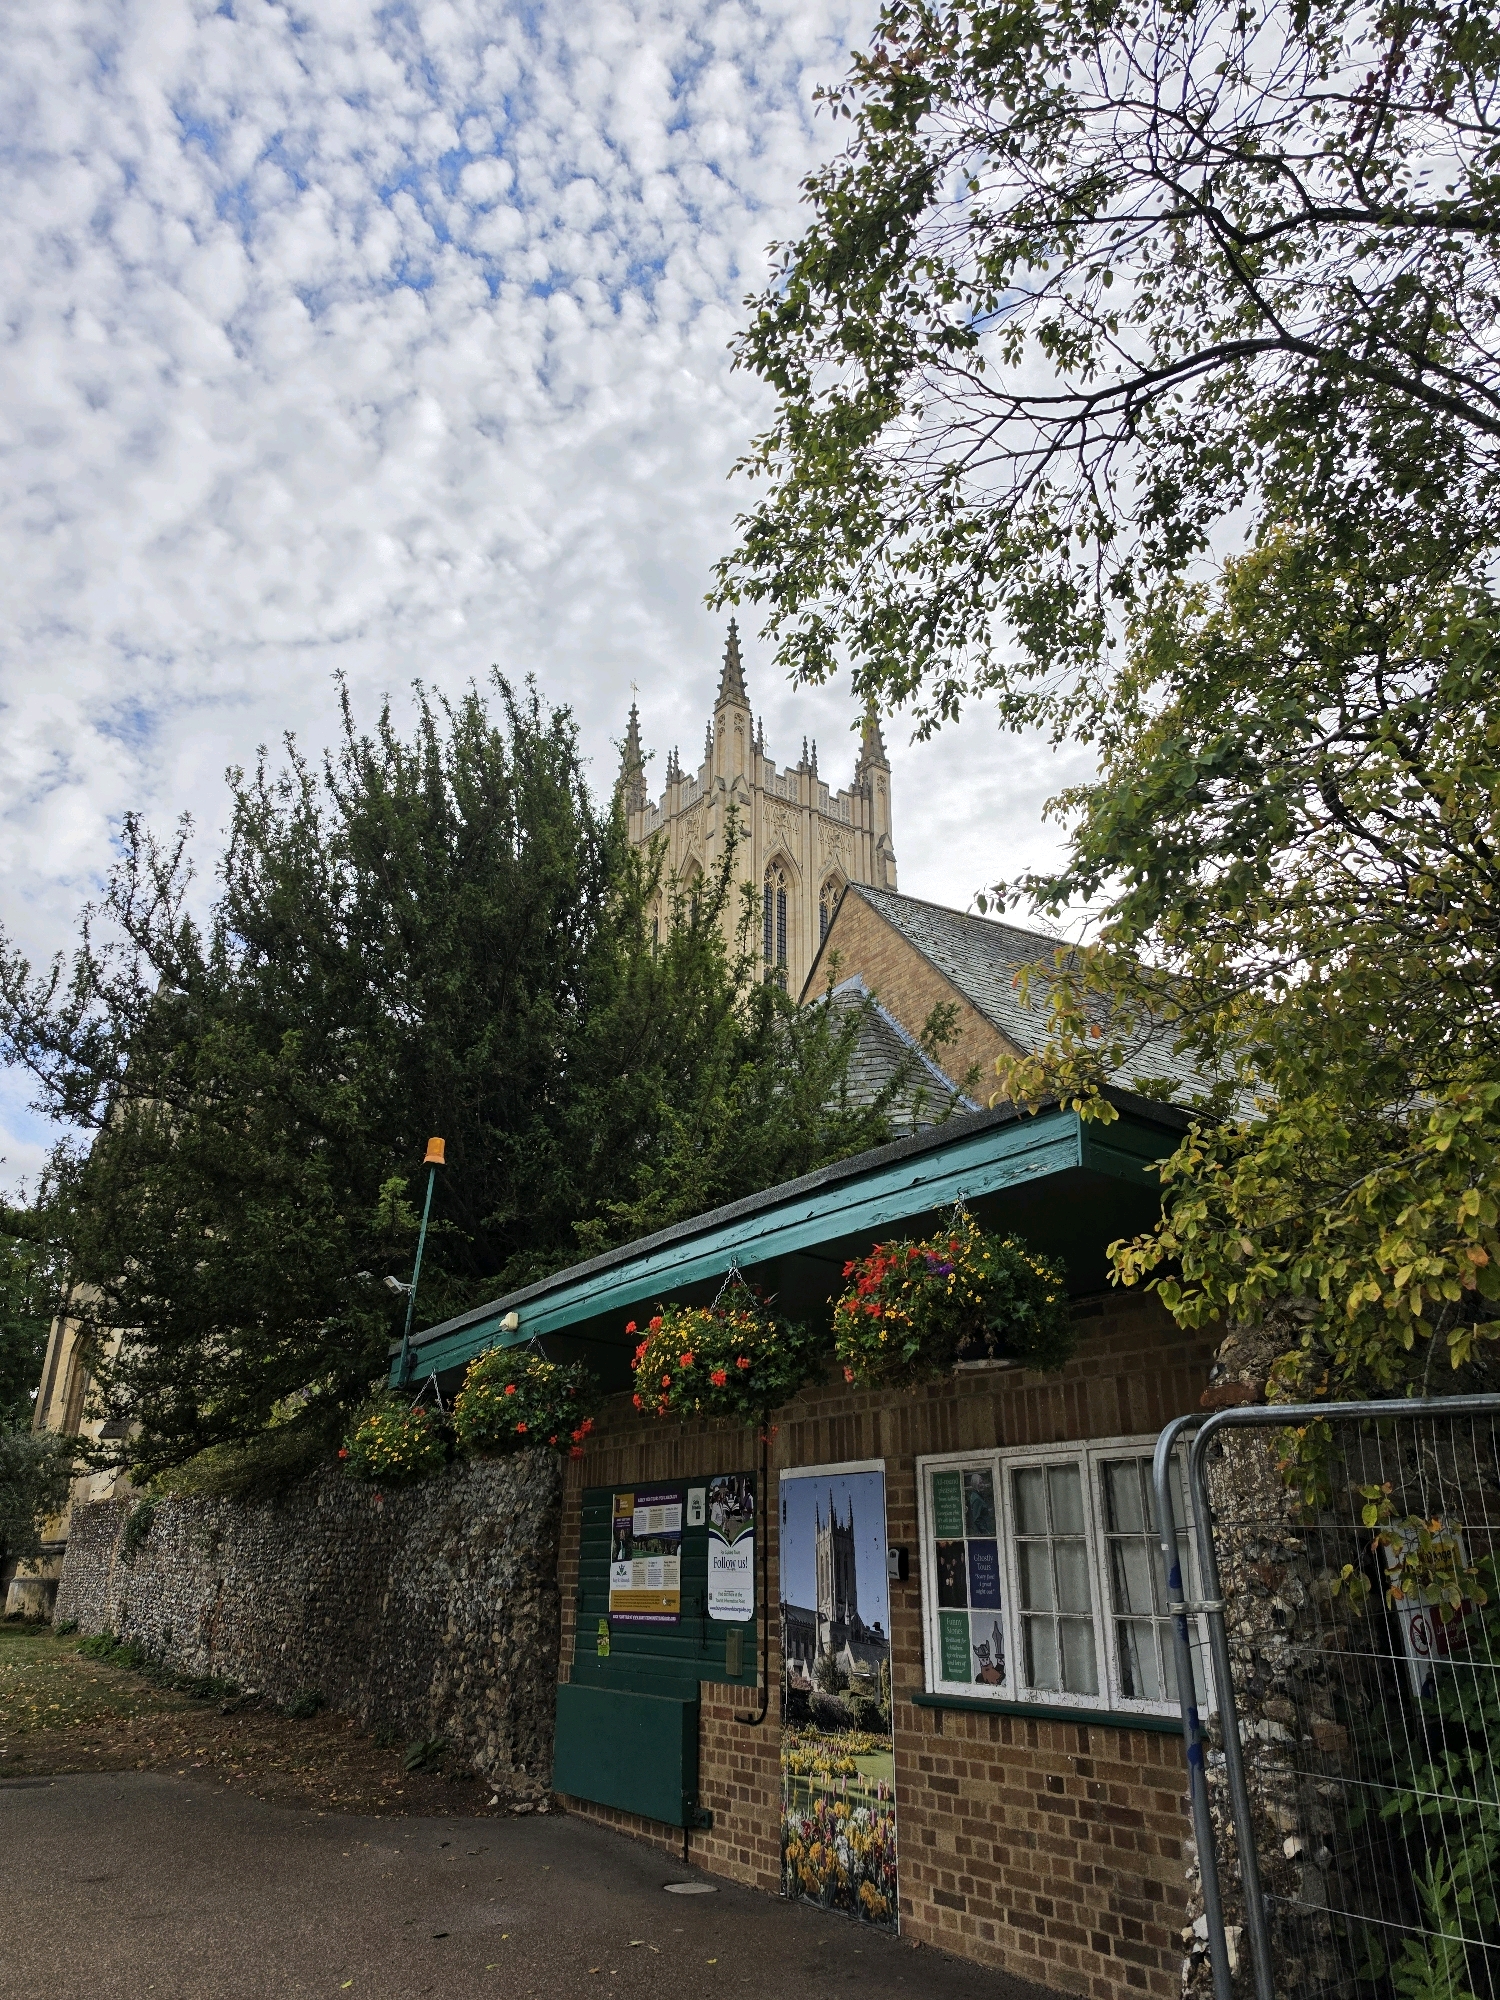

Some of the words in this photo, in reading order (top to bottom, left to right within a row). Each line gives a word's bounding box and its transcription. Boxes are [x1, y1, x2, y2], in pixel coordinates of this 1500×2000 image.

[713, 1556, 737, 1569] Follow
[738, 1556, 748, 1569] us!
[973, 1553, 994, 1563] Ghostly
[977, 1562, 992, 1571] Tours
[946, 1617, 963, 1627] Funny
[946, 1626, 963, 1635] Stories
